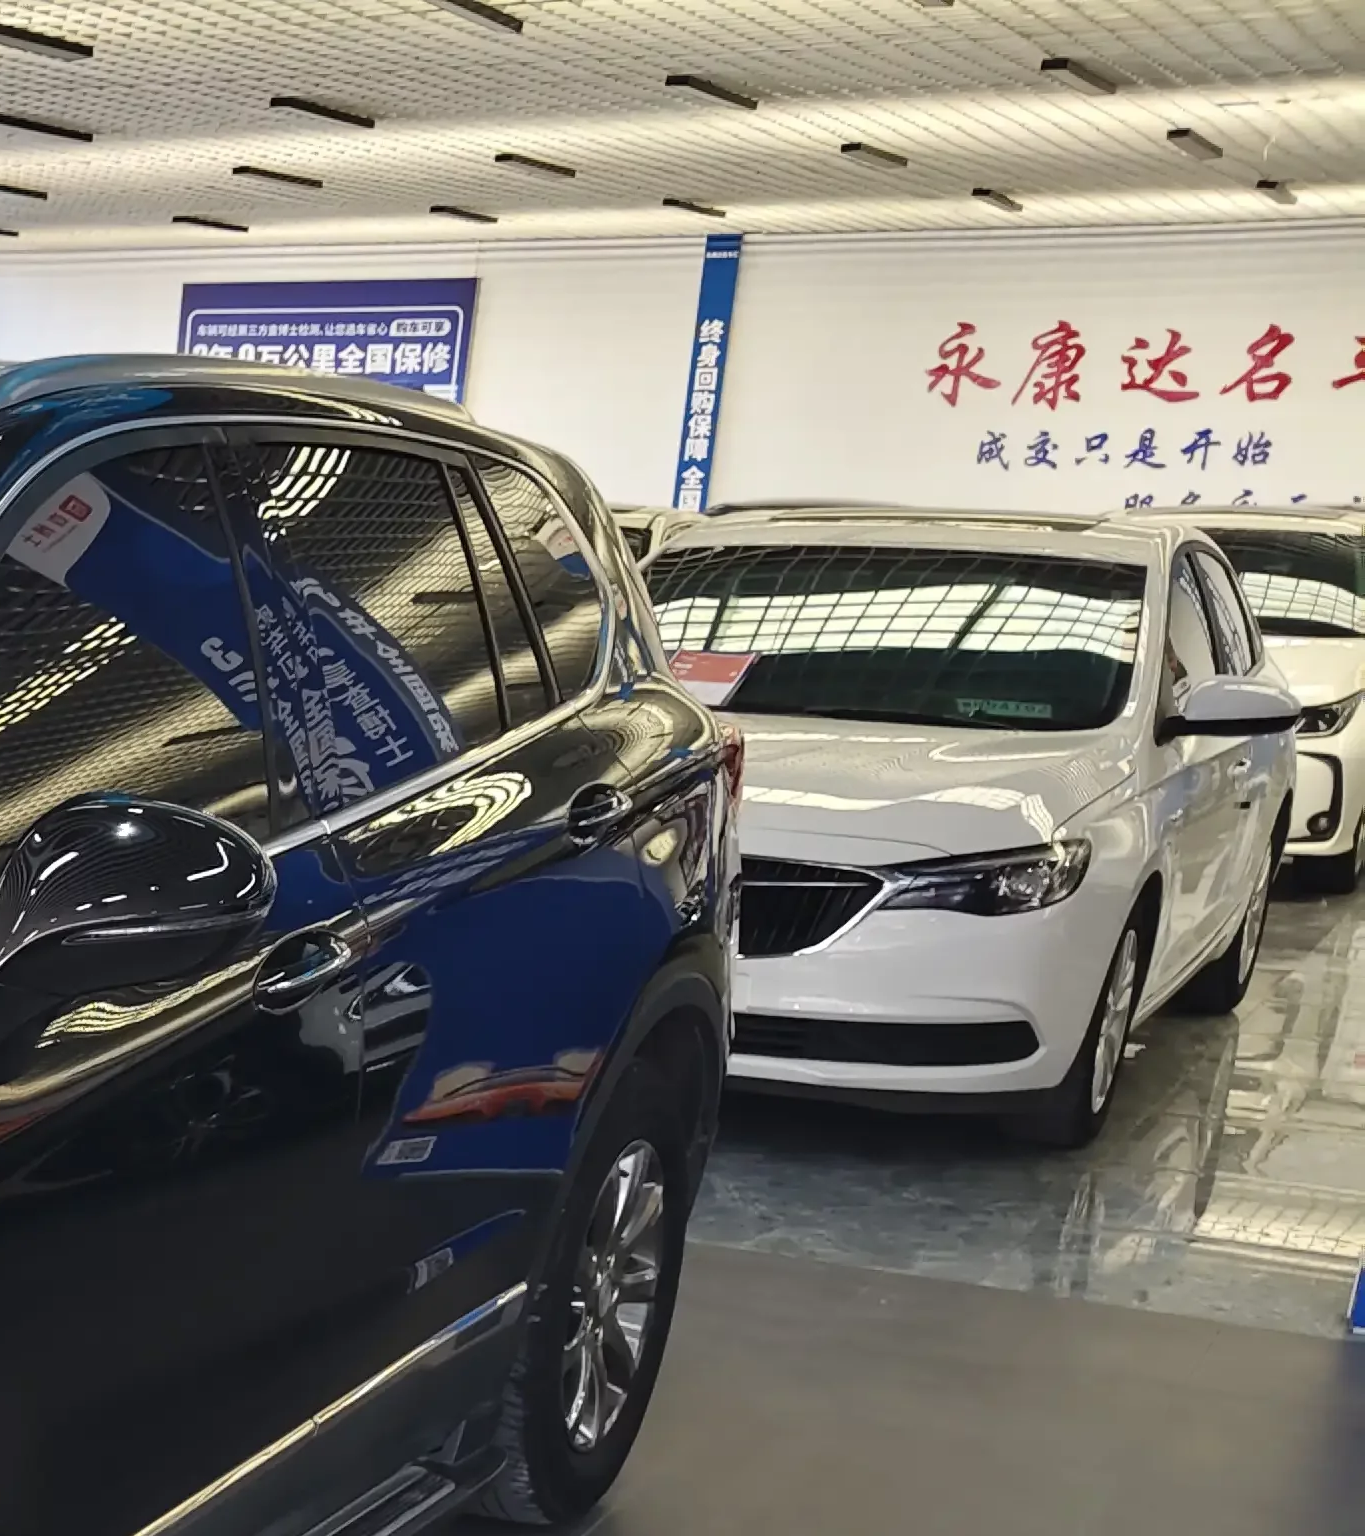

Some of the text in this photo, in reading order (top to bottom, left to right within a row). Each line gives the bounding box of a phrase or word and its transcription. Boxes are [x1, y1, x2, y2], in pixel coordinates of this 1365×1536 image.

[975, 427, 1273, 470] 成交只是开始
